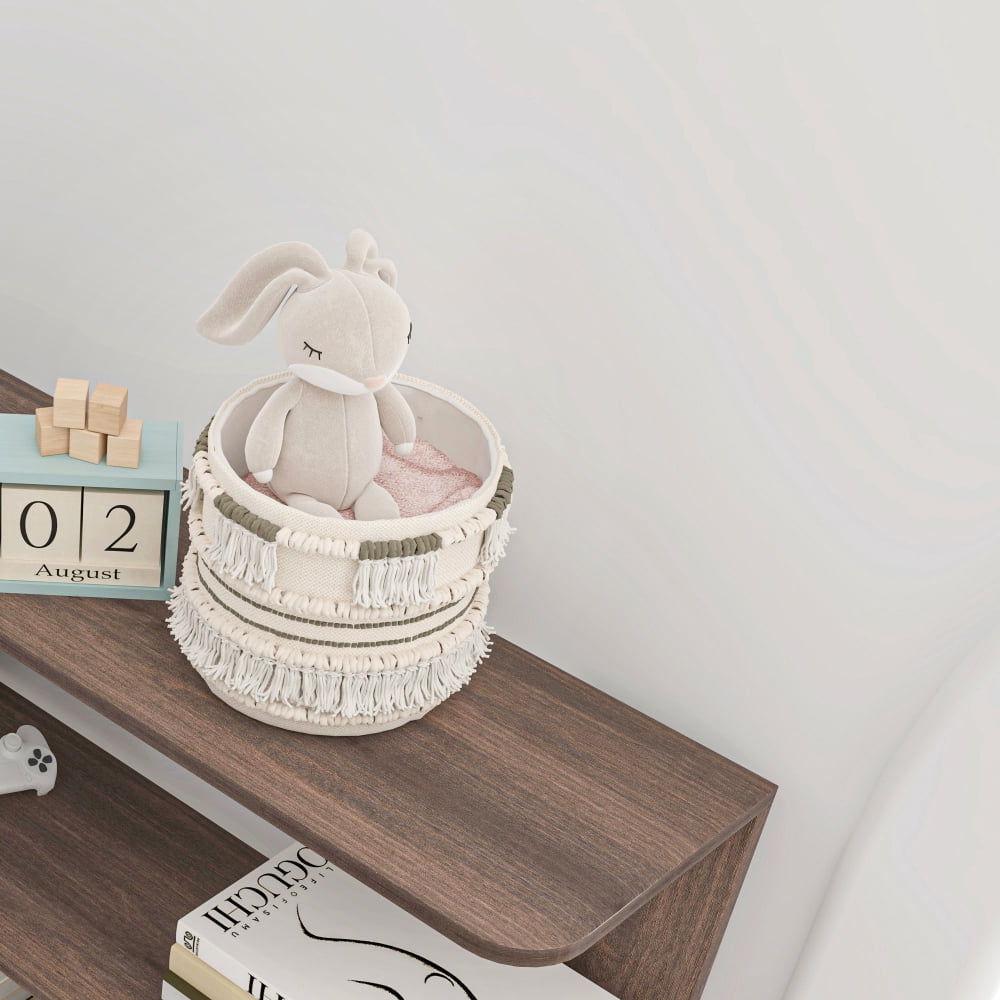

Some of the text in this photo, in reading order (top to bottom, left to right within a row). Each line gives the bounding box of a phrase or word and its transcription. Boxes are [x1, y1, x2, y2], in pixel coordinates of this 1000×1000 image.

[19, 500, 138, 552] 0 2
[35, 563, 121, 583] August
